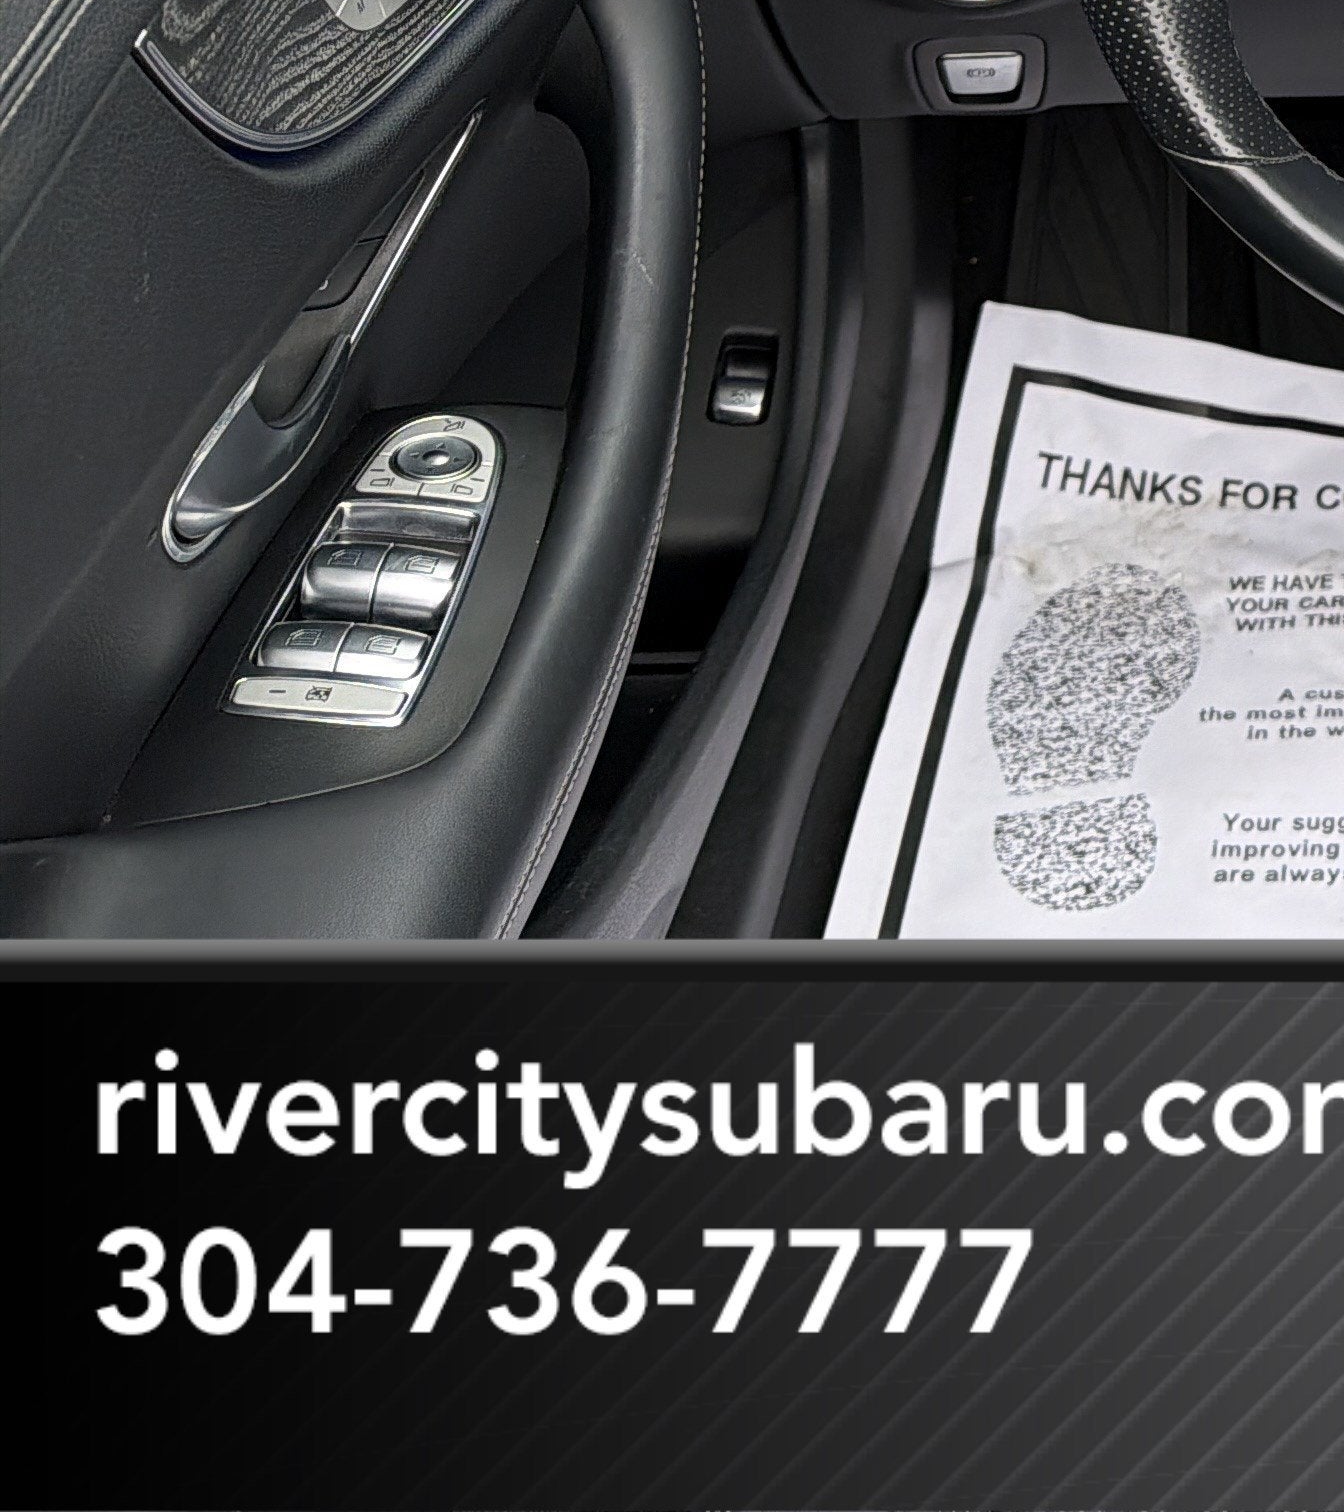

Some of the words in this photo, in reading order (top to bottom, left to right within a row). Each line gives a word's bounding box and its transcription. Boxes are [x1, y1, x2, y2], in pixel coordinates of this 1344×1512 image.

[1037, 450, 1203, 507] THANKS
[1218, 477, 1298, 510] FOR
[1228, 574, 1266, 591] WE
[1273, 573, 1335, 590] HAVE
[1226, 595, 1291, 612] YOUR
[1235, 615, 1296, 632] WITH
[1278, 687, 1295, 701] A
[1198, 707, 1237, 722] the
[1246, 704, 1306, 720] most
[1247, 724, 1268, 740] in
[1279, 723, 1316, 739] the
[1223, 812, 1282, 833] Your
[1211, 838, 1340, 860] improving
[1213, 867, 1254, 883] are
